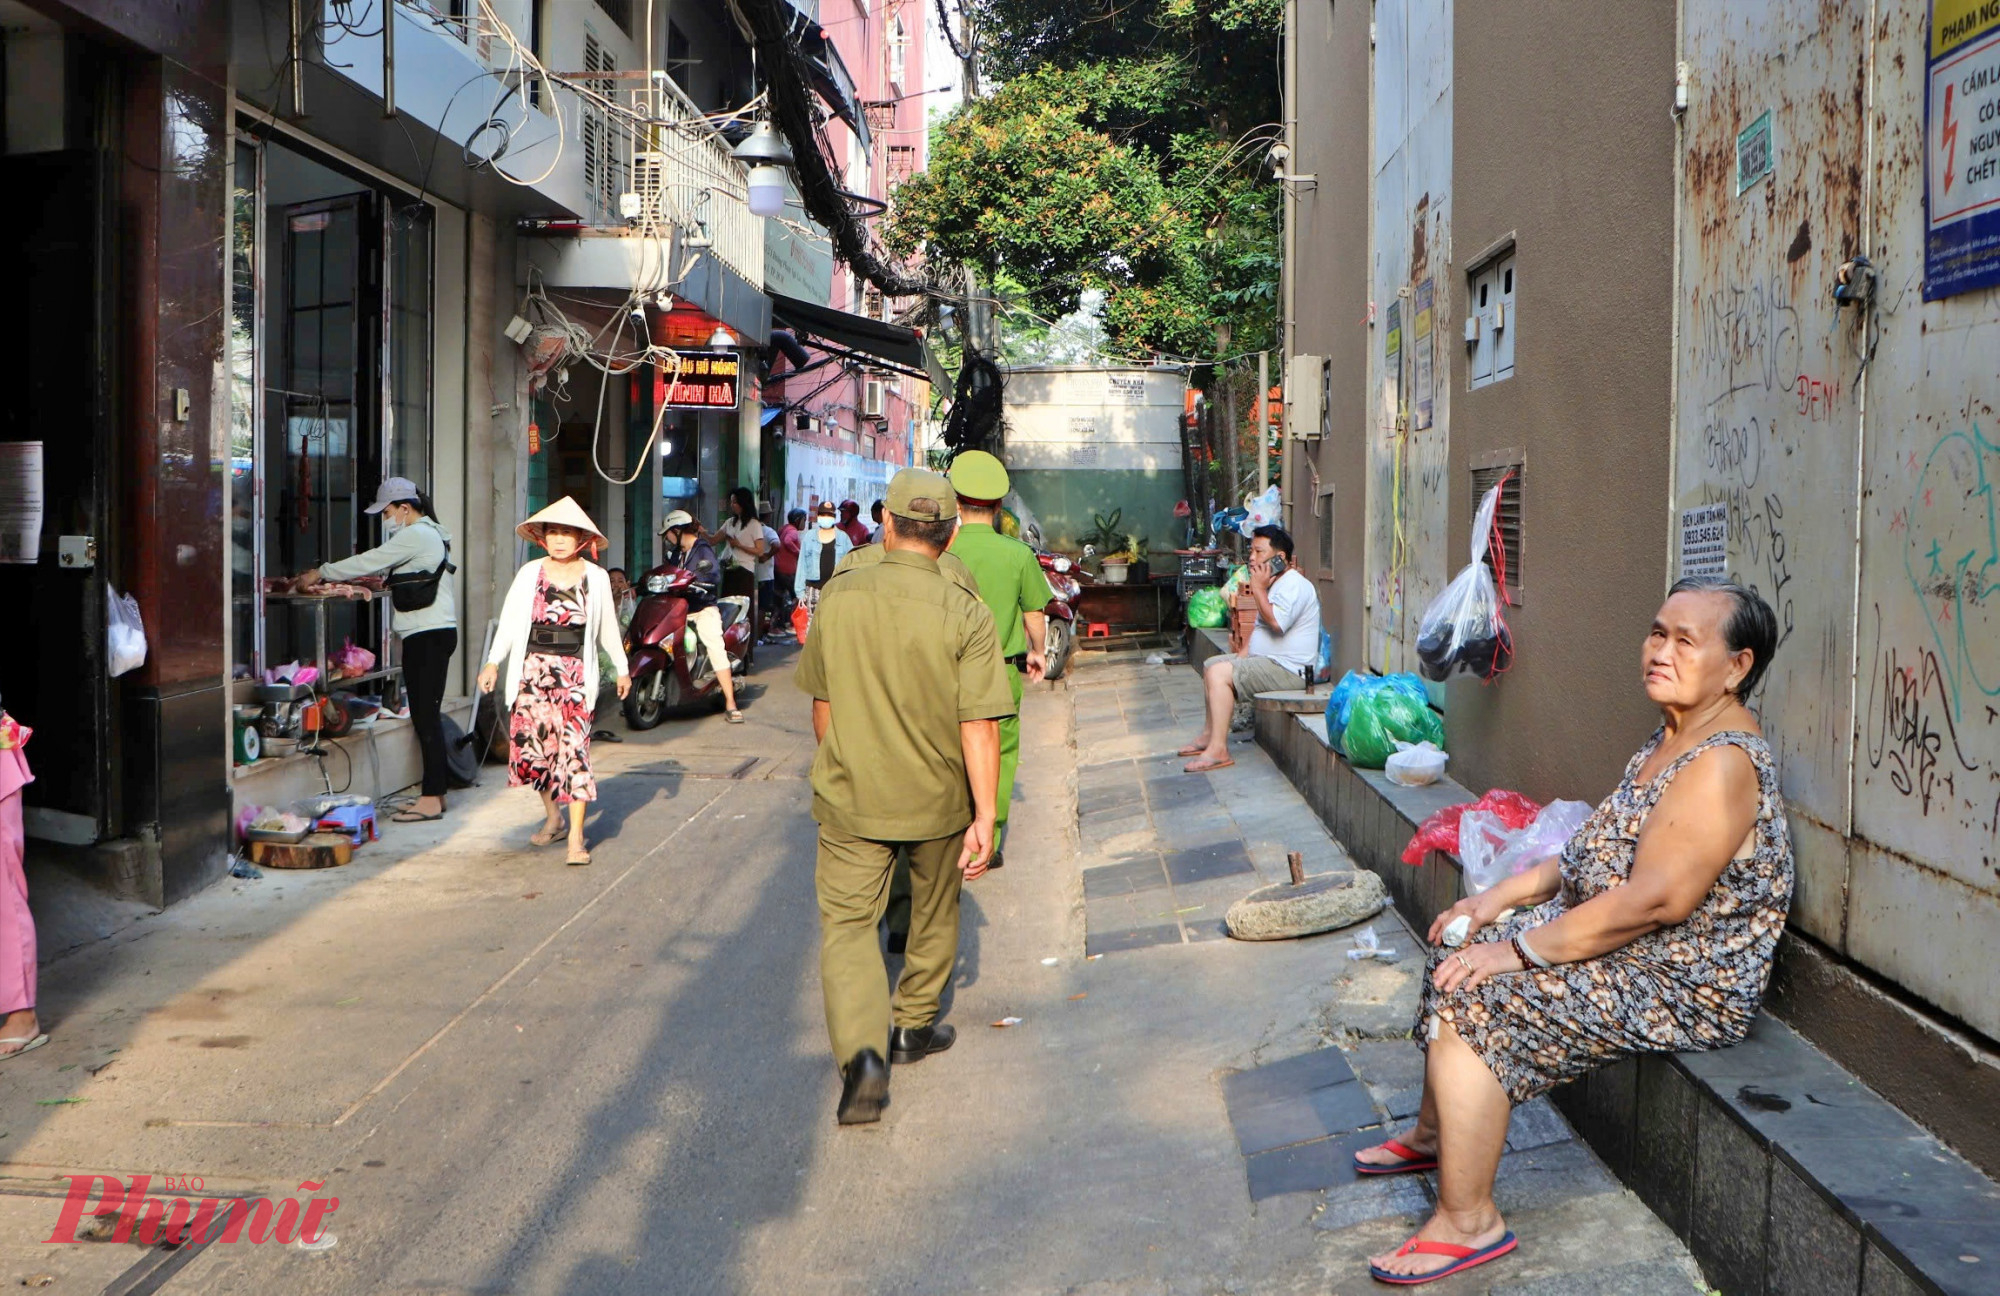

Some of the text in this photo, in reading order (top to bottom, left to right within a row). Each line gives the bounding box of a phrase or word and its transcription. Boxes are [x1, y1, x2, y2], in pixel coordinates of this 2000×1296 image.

[1942, 10, 1976, 47] PHẠM
[1962, 69, 1988, 97] CẤM
[1979, 98, 1995, 123] CÓ
[1967, 156, 1997, 185] CHẾT
[711, 358, 737, 376] NÓNG
[664, 381, 733, 404] VĨNH HÀ
